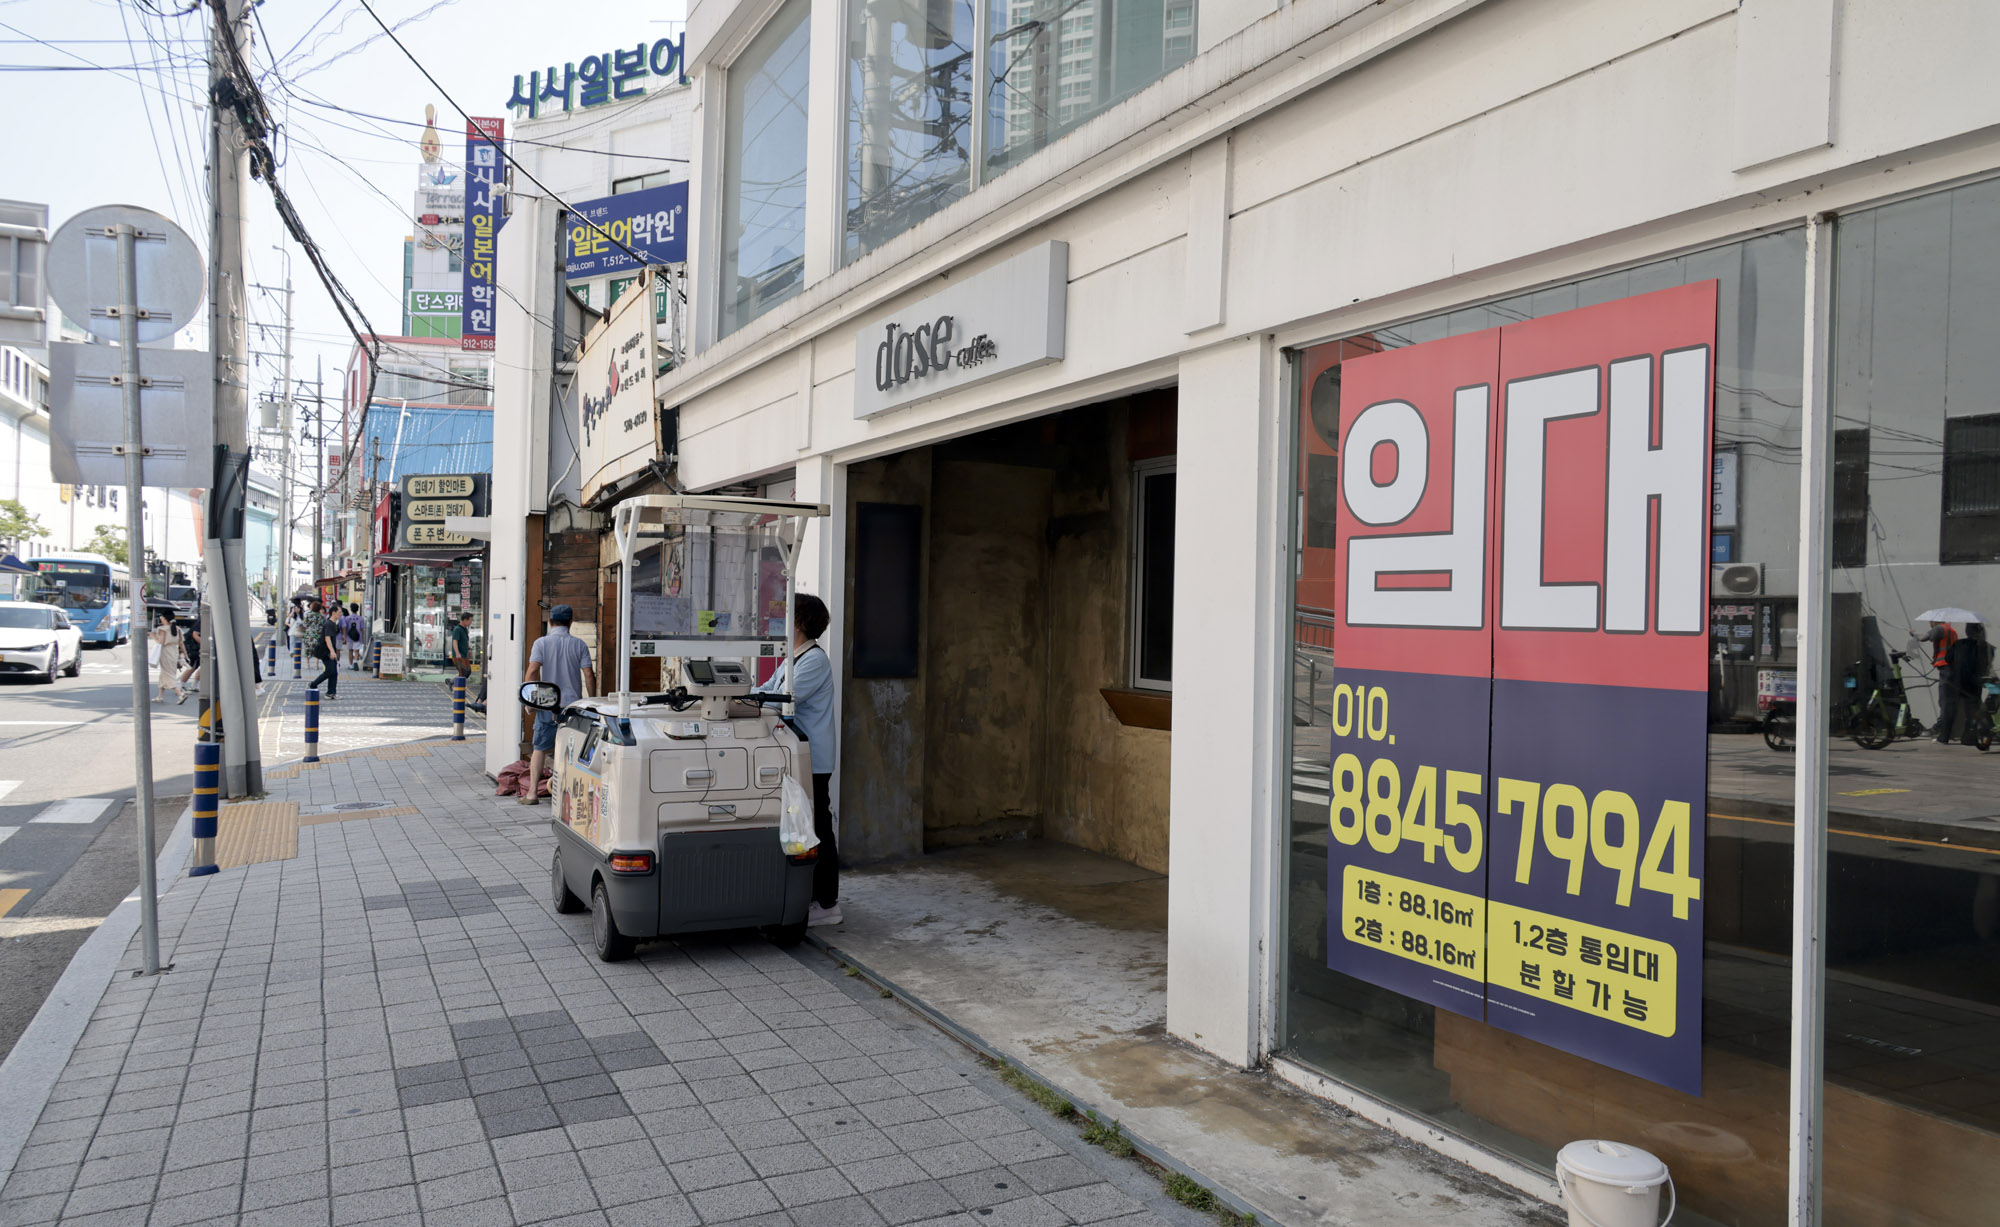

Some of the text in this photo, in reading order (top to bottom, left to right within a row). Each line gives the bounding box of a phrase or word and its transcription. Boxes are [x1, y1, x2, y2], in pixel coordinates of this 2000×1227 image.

[506, 32, 688, 118] 시사일본어
[426, 192, 464, 203] Terrac
[590, 206, 608, 217] 브랜드
[470, 168, 496, 332] 시사일본어학원
[464, 339, 496, 349] 512-158
[876, 316, 997, 392] dose coffee
[438, 479, 467, 494] 할인마트
[1342, 343, 1710, 635] 임대
[413, 527, 422, 541] 폰
[1332, 683, 1396, 745] 010.
[1330, 753, 1700, 920] 8845 7994
[1357, 879, 1381, 905] 1층
[1355, 916, 1383, 944] 2층
[1513, 920, 1659, 983] 1.2층 통임대
